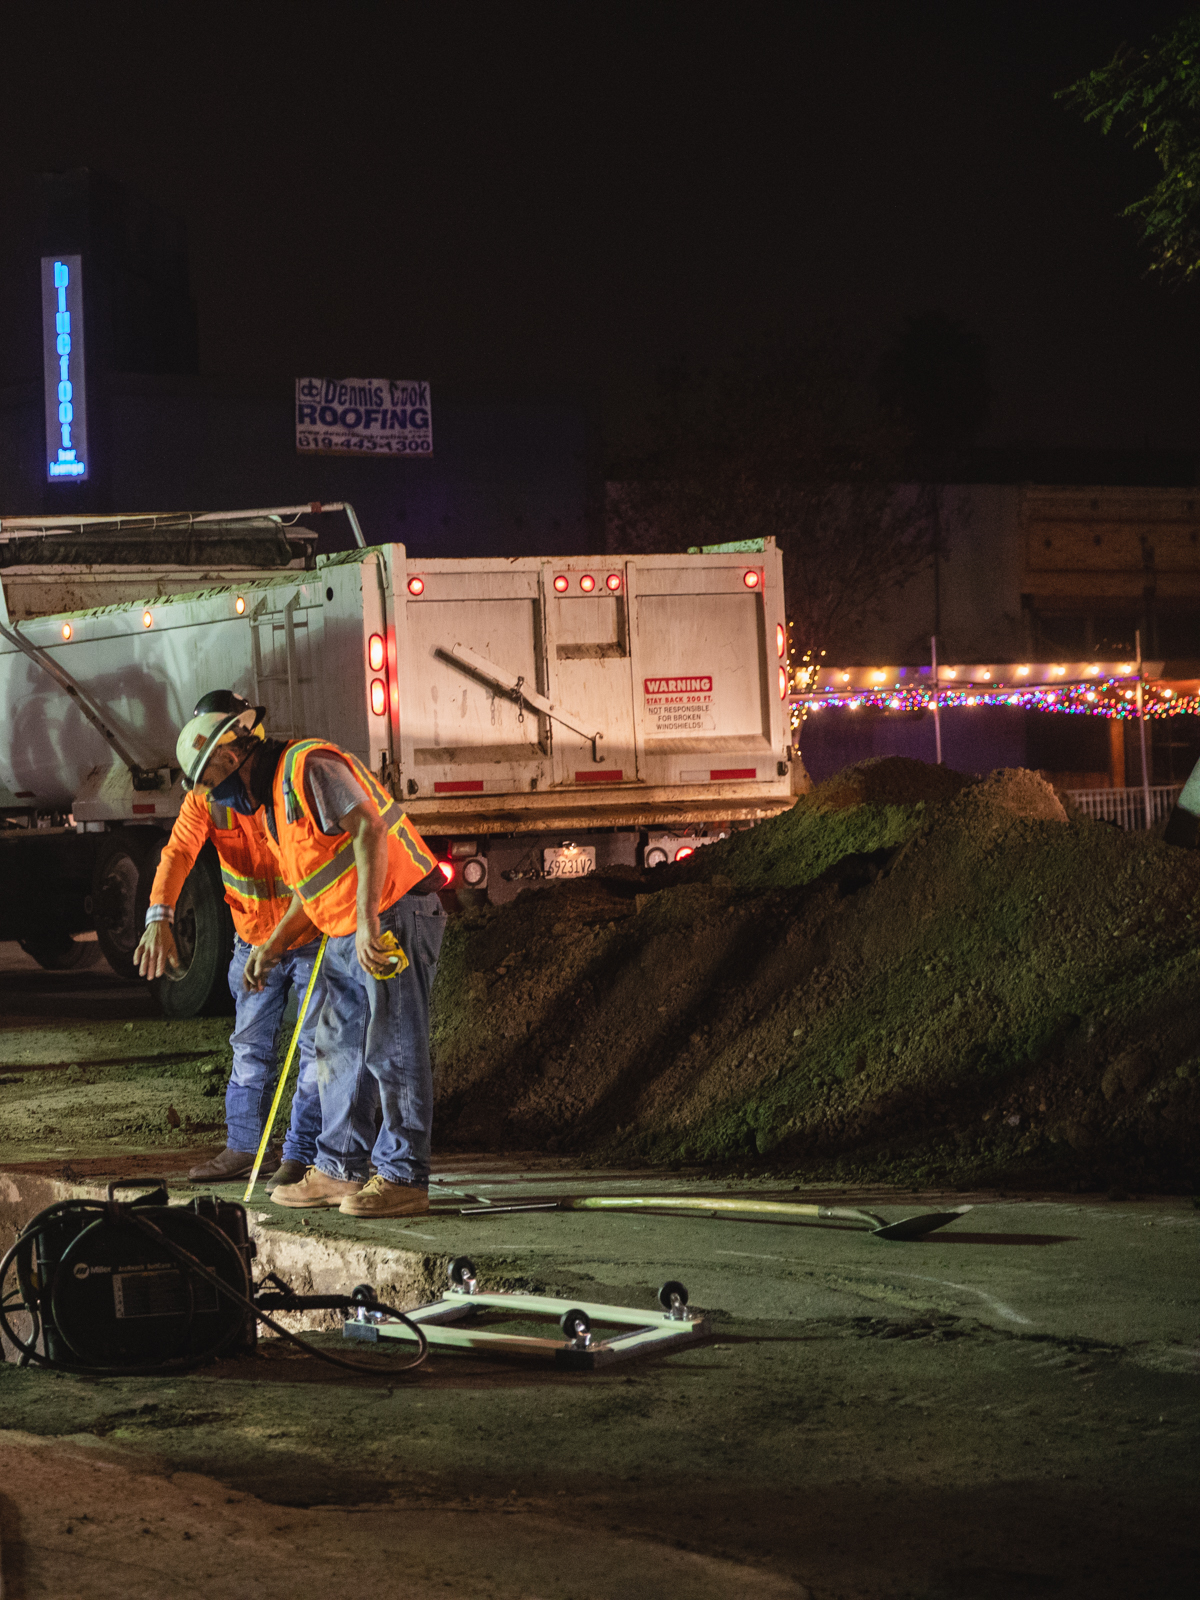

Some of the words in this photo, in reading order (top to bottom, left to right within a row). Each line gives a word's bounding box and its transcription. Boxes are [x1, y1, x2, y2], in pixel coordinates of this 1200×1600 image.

[54, 261, 73, 448] bluefoot
[324, 379, 383, 407] Dennis
[389, 381, 428, 407] Cook
[298, 404, 429, 429] ROOFING
[298, 436, 431, 452] 619-443-1300
[646, 678, 711, 692] WARNING
[648, 706, 662, 714] NOT
[664, 705, 709, 713] RESPONSIBLE
[656, 722, 704, 730] WINDSHIELDS!
[90, 1266, 112, 1274] Miller
